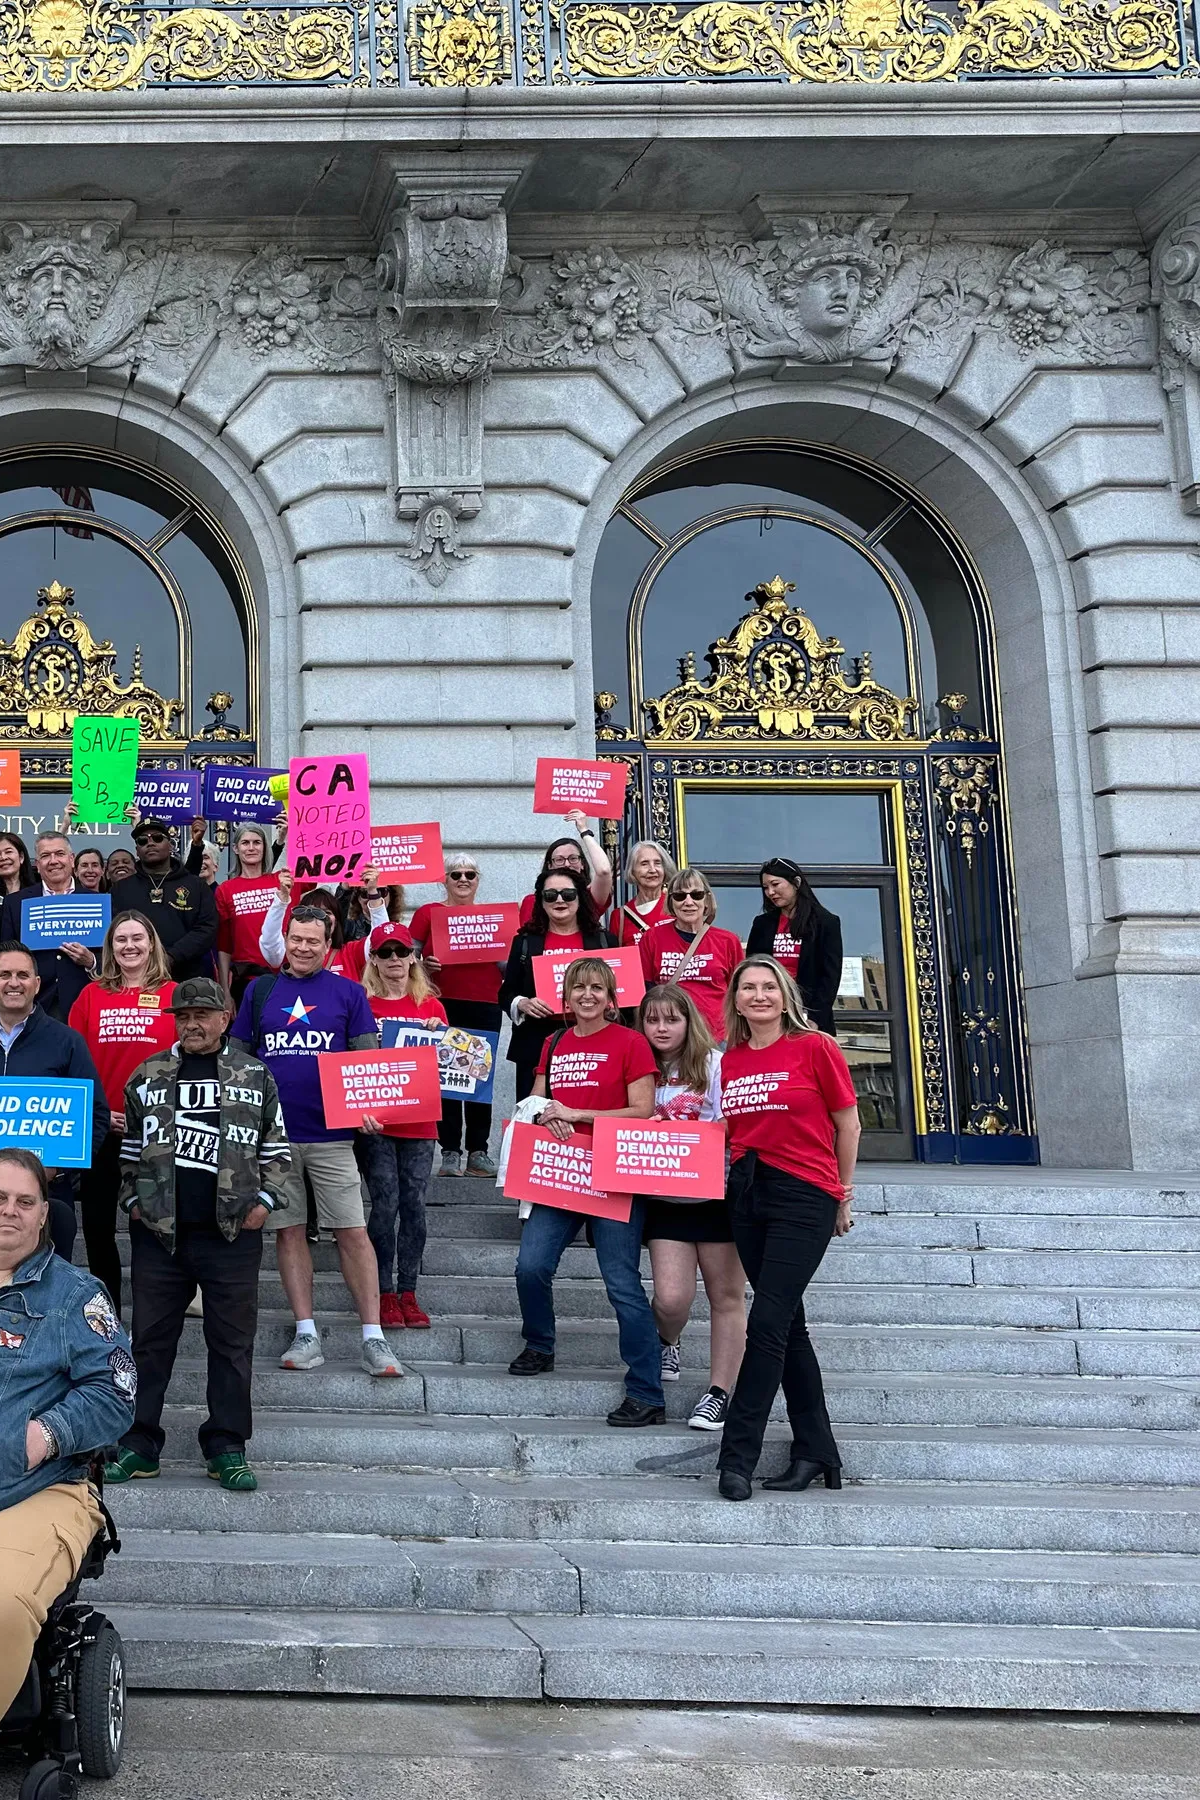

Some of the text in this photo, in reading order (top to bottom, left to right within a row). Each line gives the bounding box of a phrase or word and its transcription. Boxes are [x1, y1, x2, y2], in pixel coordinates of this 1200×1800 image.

[79, 727, 136, 753] SAVE
[77, 764, 91, 791] S.
[295, 763, 355, 796] CA
[553, 768, 590, 779] MOMS
[160, 782, 190, 794] GUN
[216, 777, 244, 789] END
[552, 777, 604, 789] DEMAND
[94, 781, 109, 806] B.
[214, 791, 276, 807] VIOLENCE
[551, 786, 597, 798] ACTION
[294, 804, 366, 827] VOTED
[295, 830, 365, 853] & SAID
[371, 845, 418, 857] EMAND
[294, 852, 364, 879] NO!
[371, 855, 412, 867] CTION
[232, 889, 262, 900] MOMS
[233, 893, 275, 906] DEMAND
[235, 900, 270, 912] ACTION
[29, 919, 102, 932] EVERYTOWN
[447, 915, 484, 926] MOMS
[448, 924, 499, 935] DEMAND
[449, 933, 493, 944] ACTION
[100, 1007, 139, 1018] MOMS
[99, 1016, 154, 1027] DEMAND
[98, 1025, 146, 1037] ACTION
[264, 1030, 335, 1052] BRADY
[551, 1052, 586, 1065] MOMS
[340, 1062, 390, 1077] MOMS
[550, 1061, 598, 1074] DEMAND
[342, 1073, 411, 1089] DEMAND
[549, 1071, 589, 1084] ACTION
[726, 1073, 764, 1089] MOMS
[345, 1086, 404, 1102] ACTION
[722, 1082, 779, 1098] DEMAND
[25, 1096, 72, 1114] GUN
[395, 1098, 420, 1106] AMERICA
[721, 1092, 768, 1111] ACTION
[142, 1114, 170, 1148] PL
[616, 1129, 670, 1143] MOMS
[533, 1139, 585, 1160] MOMS
[616, 1141, 691, 1157] DEMAND
[532, 1151, 592, 1174] DEMAN
[615, 1154, 681, 1169] ACTION
[529, 1164, 593, 1187] ACTION
[642, 1169, 662, 1177] SENSE
[670, 1171, 699, 1179] AMERICA
[528, 1177, 541, 1185] FOR
[541, 1179, 554, 1187] GUN
[554, 1182, 573, 1192] SENSE
[580, 1187, 608, 1198] AMERICA
